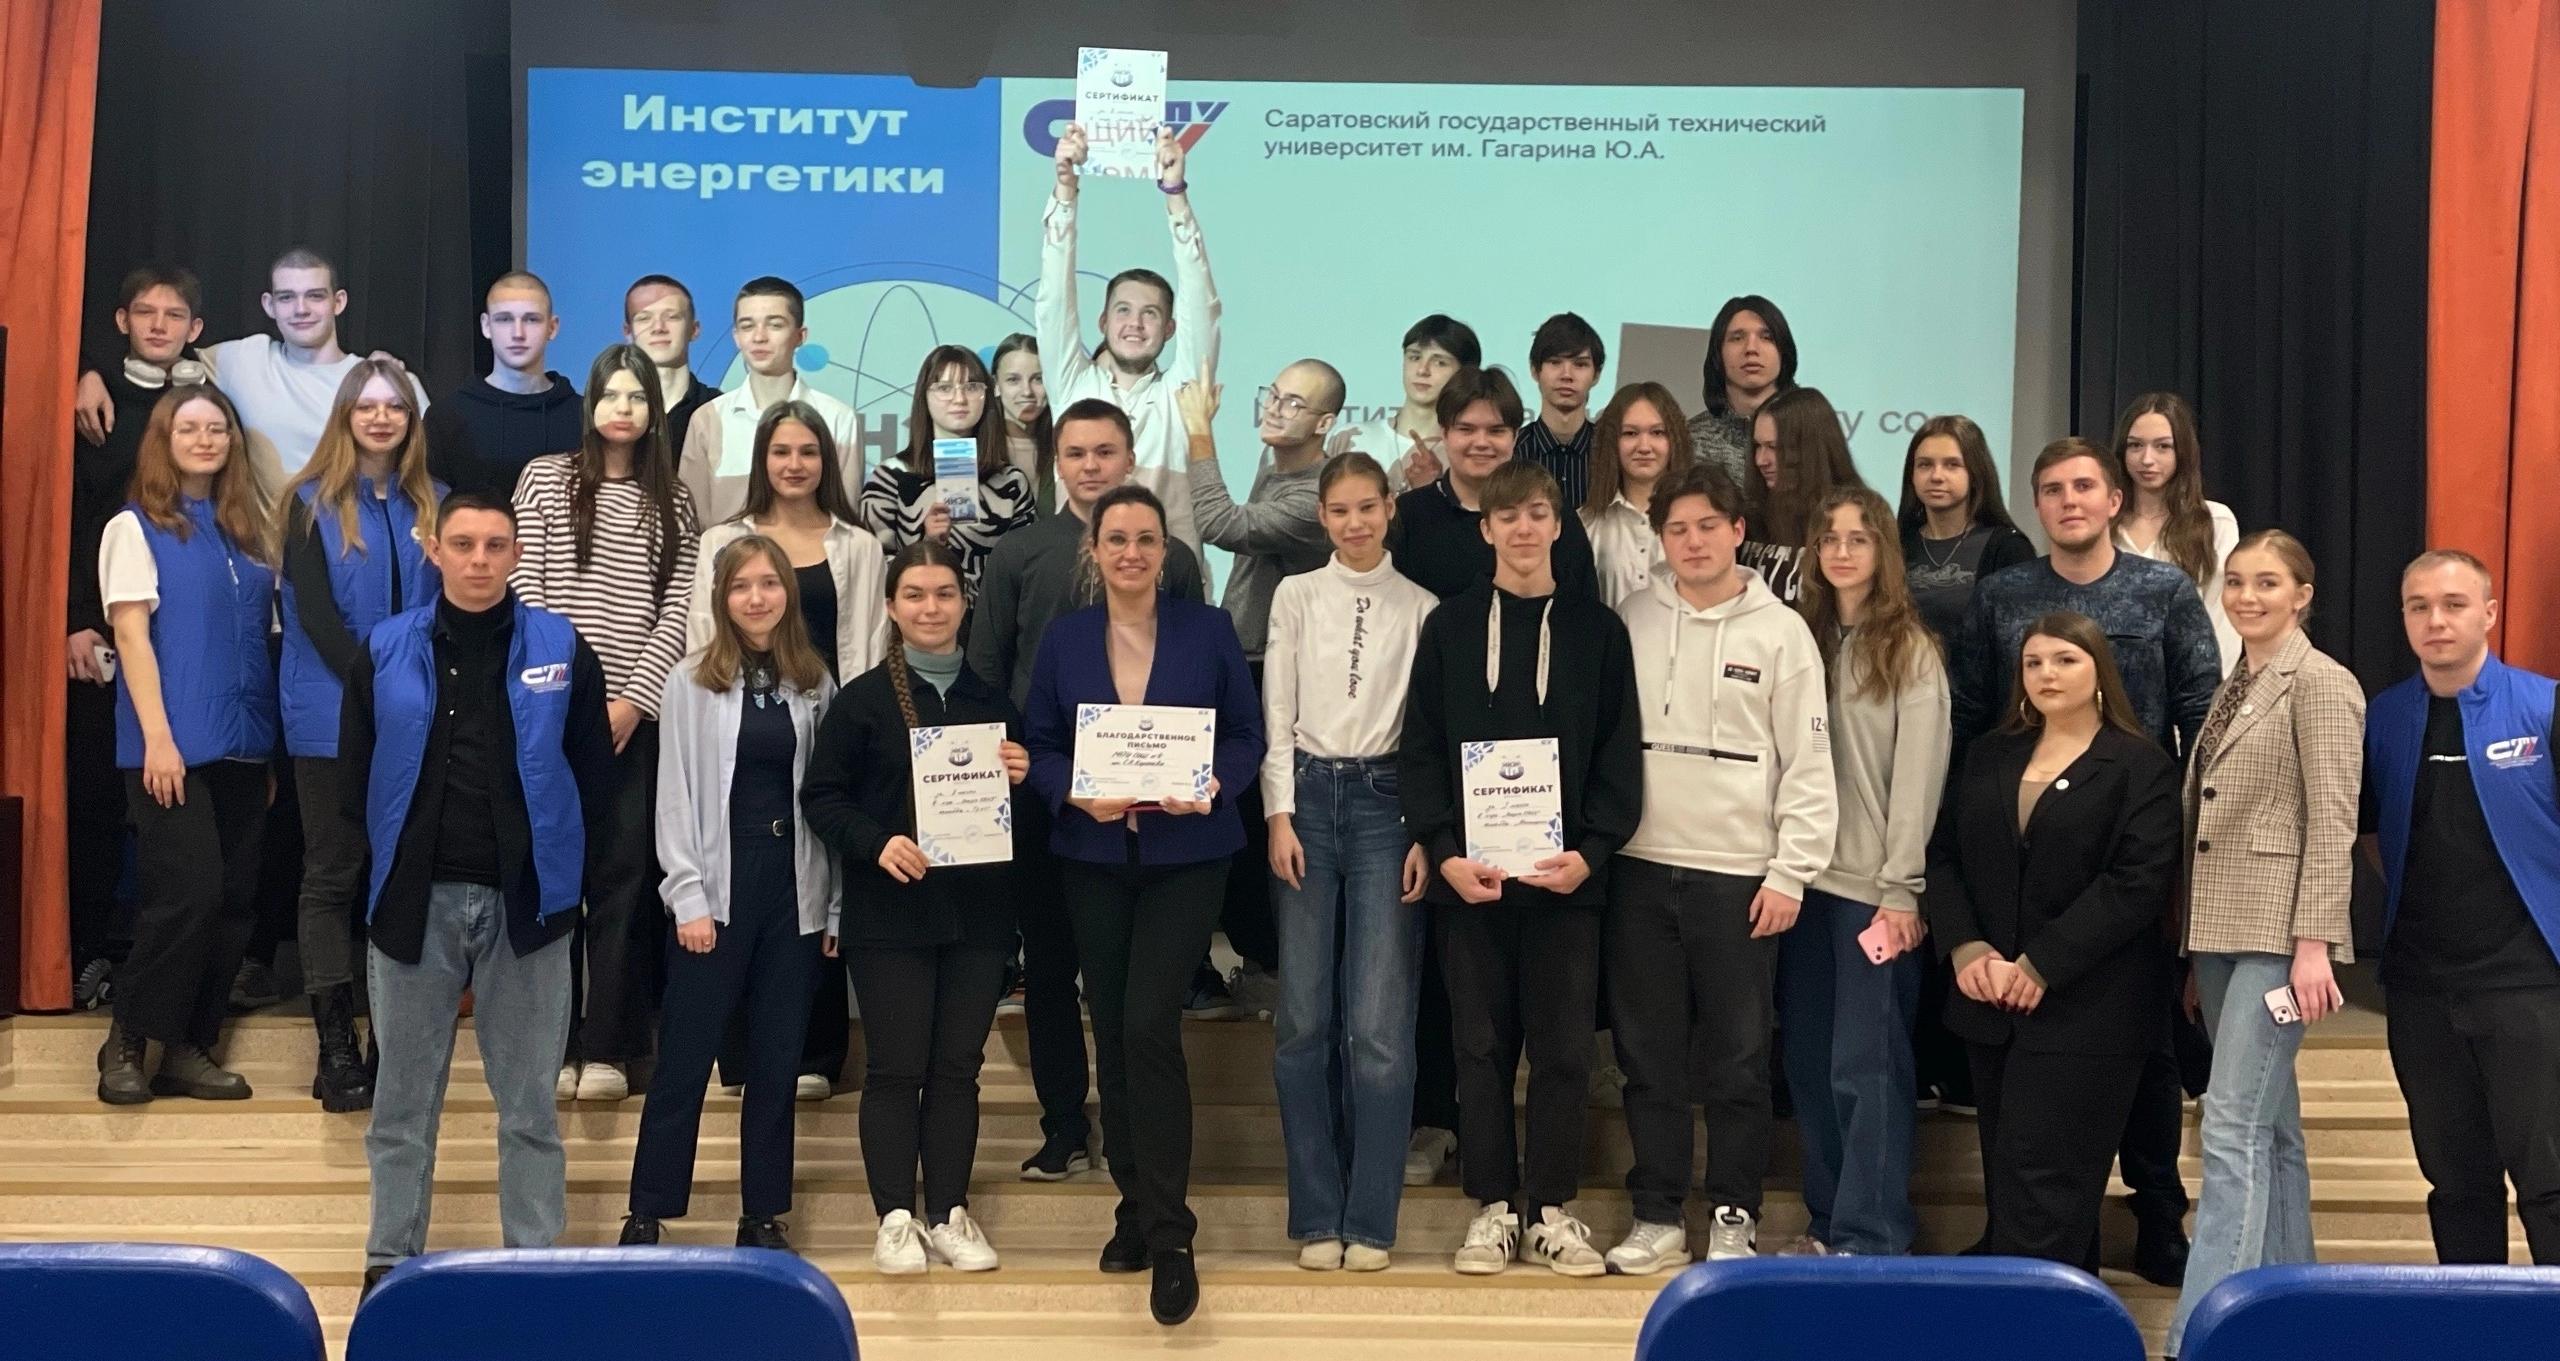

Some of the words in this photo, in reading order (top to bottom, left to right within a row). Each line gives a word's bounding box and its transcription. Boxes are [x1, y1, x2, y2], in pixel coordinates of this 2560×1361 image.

[1085, 91, 1159, 103] СЕРТИФИКАТ
[623, 94, 908, 144] Институт
[1264, 107, 1430, 132] Саратовский
[1438, 112, 1659, 135] государственный
[1668, 113, 1826, 133] технический
[1263, 140, 1424, 160] университет
[1431, 142, 1473, 158] им.
[1481, 139, 1596, 162] Гагарина
[1604, 140, 1666, 160] Ю.А.
[581, 159, 944, 199] энергетики
[1096, 731, 1196, 742] БЛАГОДАРСТВЕННОЕ
[1127, 741, 1167, 749] ПИСЬМО
[923, 769, 1002, 784] СЕРТИФИКАТ
[1473, 784, 1553, 796] СЕРТИФИКАТ
